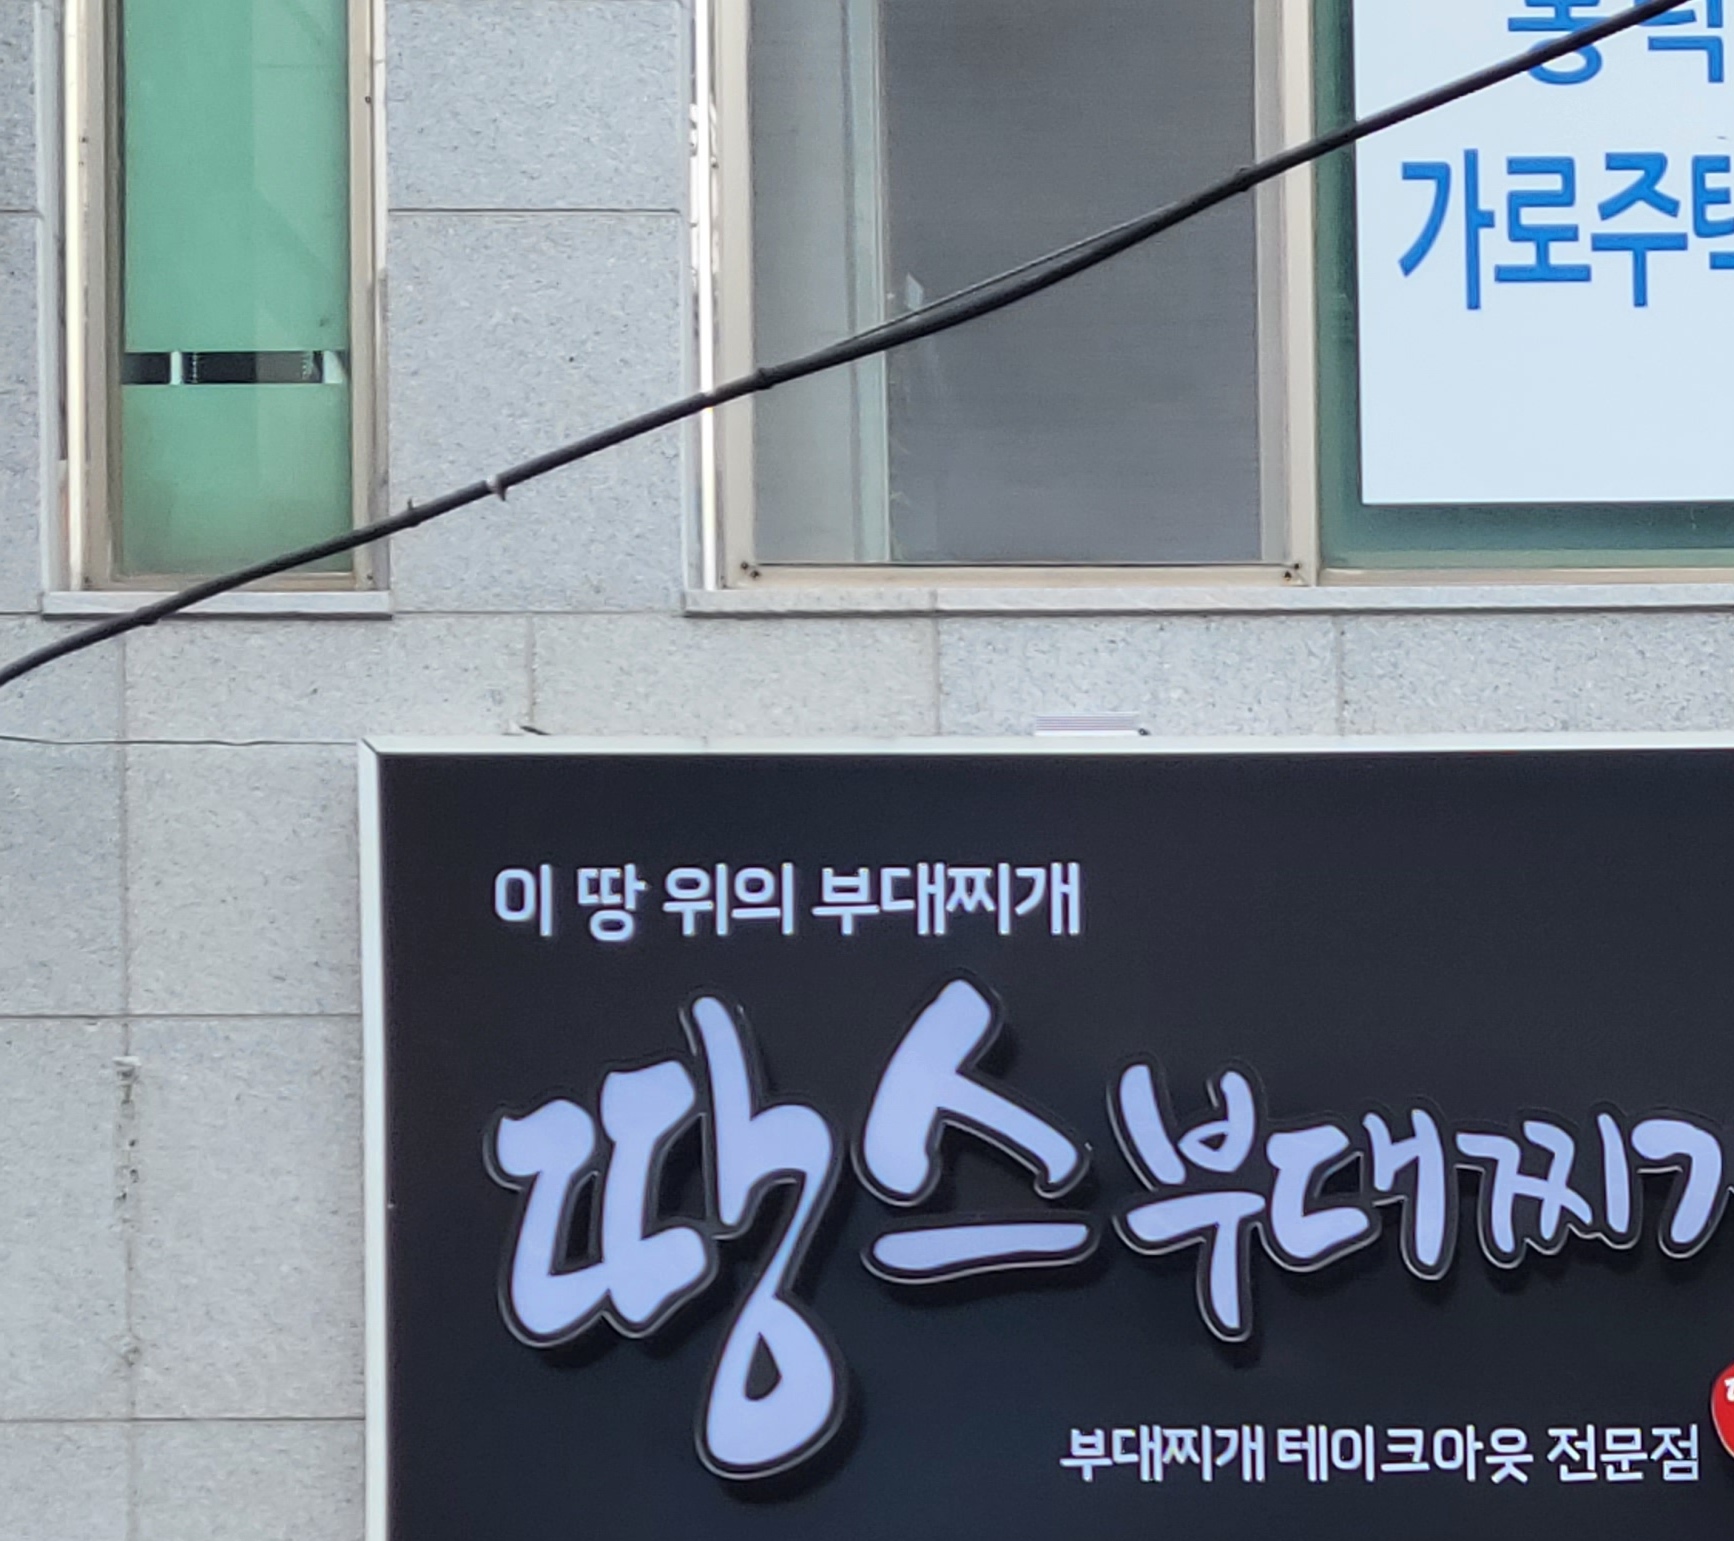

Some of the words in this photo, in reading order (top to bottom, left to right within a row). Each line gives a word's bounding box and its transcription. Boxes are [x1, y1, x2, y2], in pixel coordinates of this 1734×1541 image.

[493, 863, 554, 935] 이
[576, 863, 646, 942] 땅
[662, 862, 796, 935] 위의
[811, 861, 1083, 936] 부대찌개
[1059, 1426, 1266, 1482] 부대찌개
[1276, 1424, 1532, 1483] 테이크아웃
[1547, 1424, 1700, 1481] 전문점
